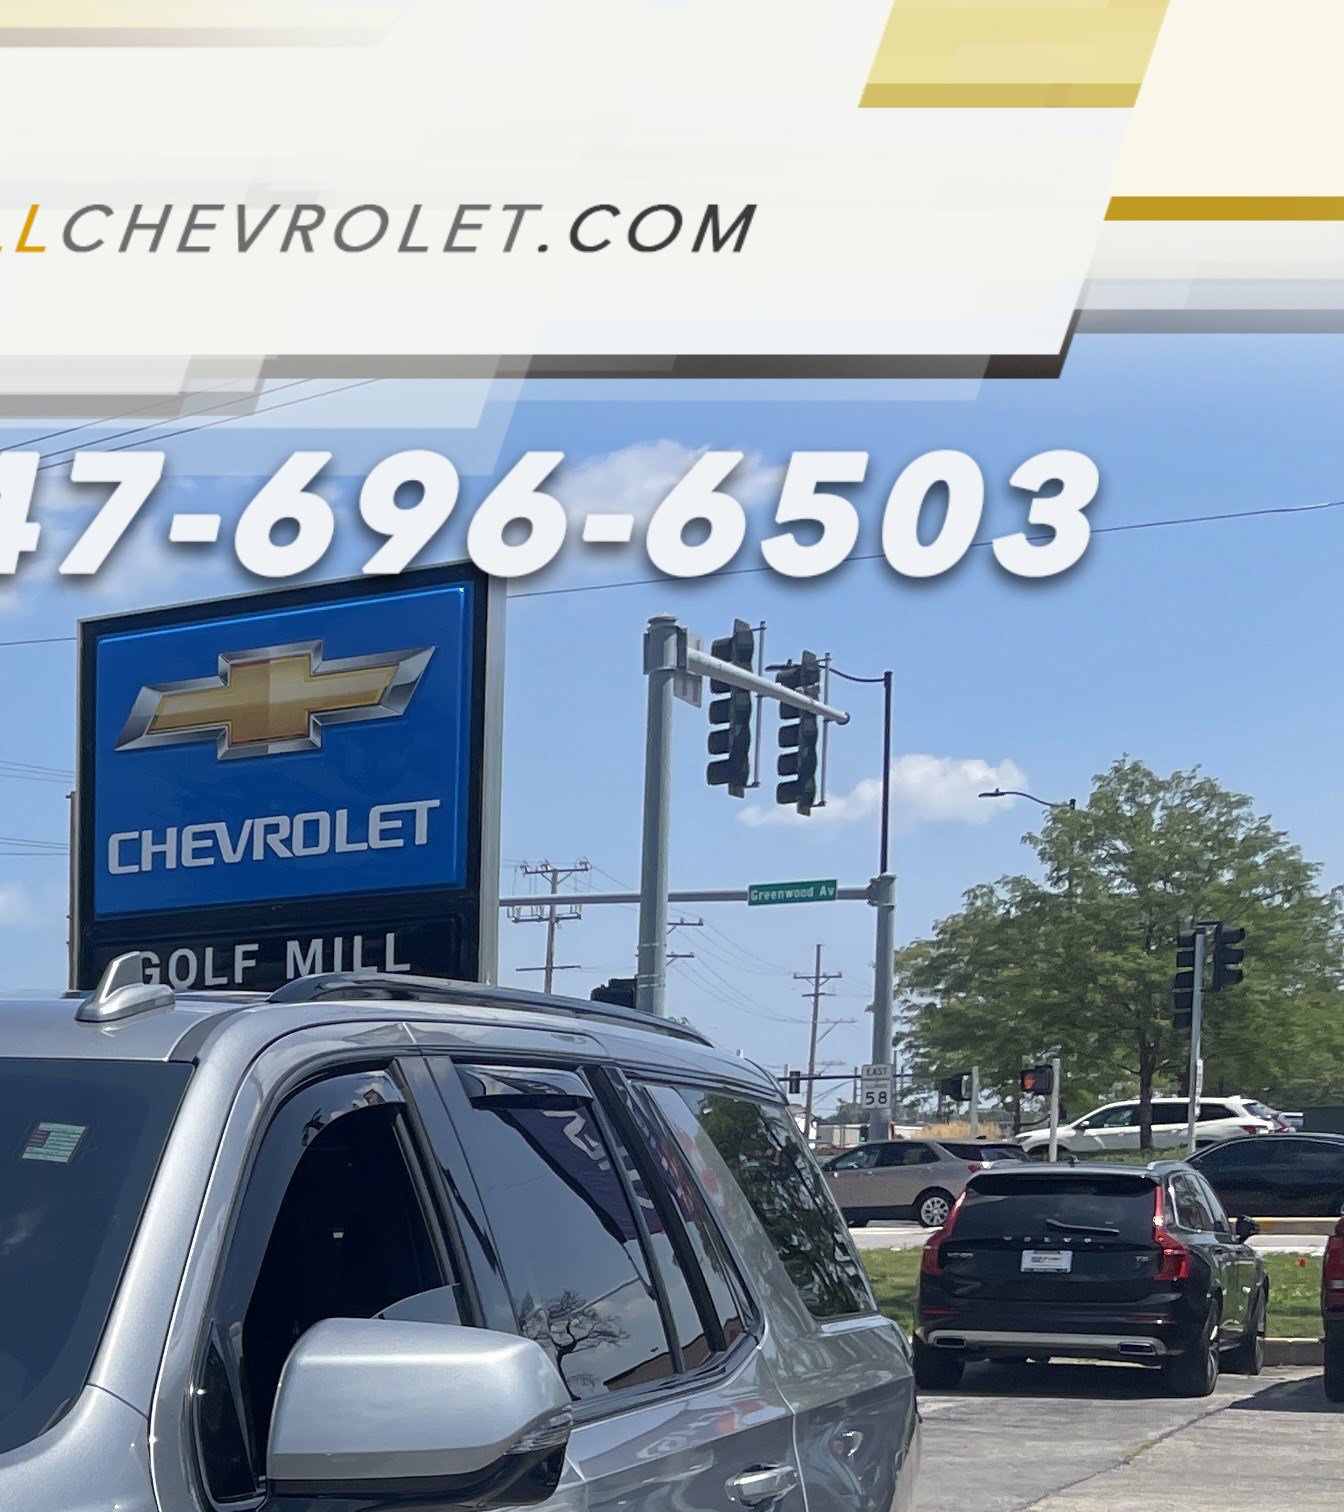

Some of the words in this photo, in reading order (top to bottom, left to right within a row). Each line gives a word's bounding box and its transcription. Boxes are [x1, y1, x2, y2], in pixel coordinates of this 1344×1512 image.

[106, 798, 441, 877] CHEVROLET
[750, 887, 814, 901] Greenwood
[819, 885, 835, 897] Av
[140, 942, 260, 991] GOLF
[285, 932, 411, 980] MILL
[866, 1066, 888, 1076] EAST
[865, 1091, 887, 1105] 58
